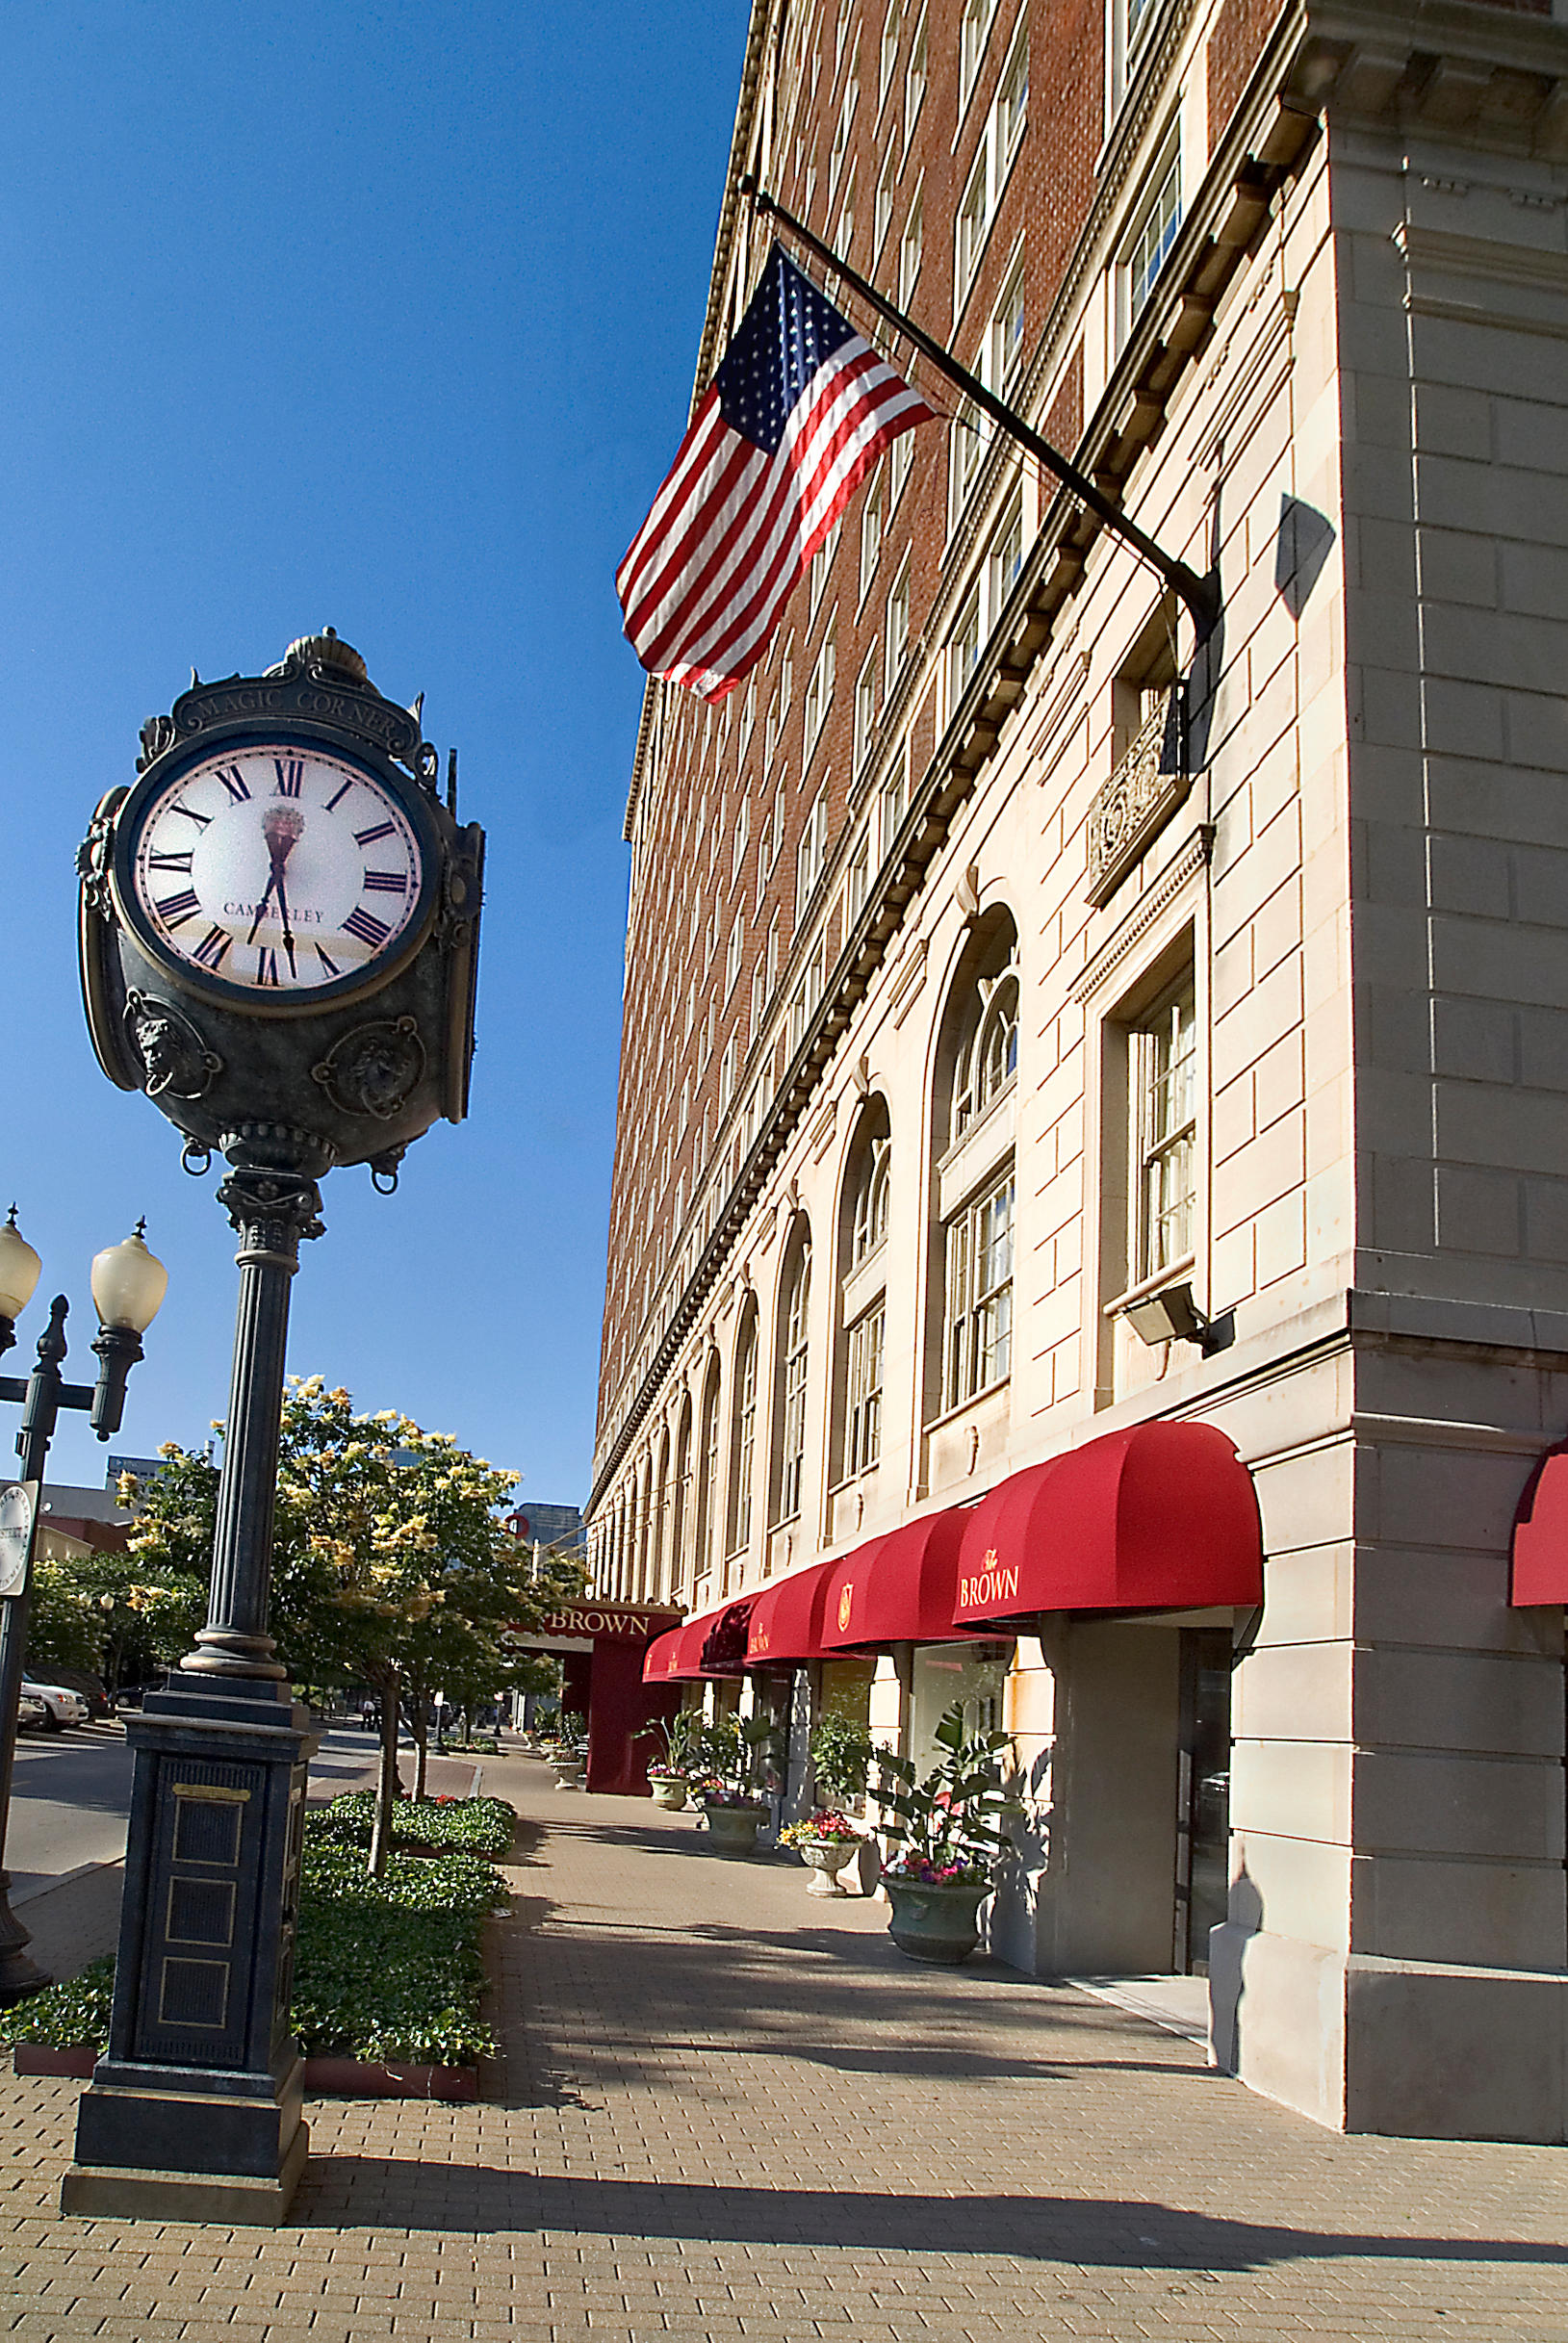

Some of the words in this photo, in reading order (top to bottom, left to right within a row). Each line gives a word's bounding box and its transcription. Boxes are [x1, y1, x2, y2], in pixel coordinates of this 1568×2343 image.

[197, 688, 282, 718] MAGIC
[296, 691, 396, 737] CORNER
[270, 759, 304, 798] XII
[960, 1565, 1019, 1608] BROWN
[550, 1611, 650, 1635] BROWN
